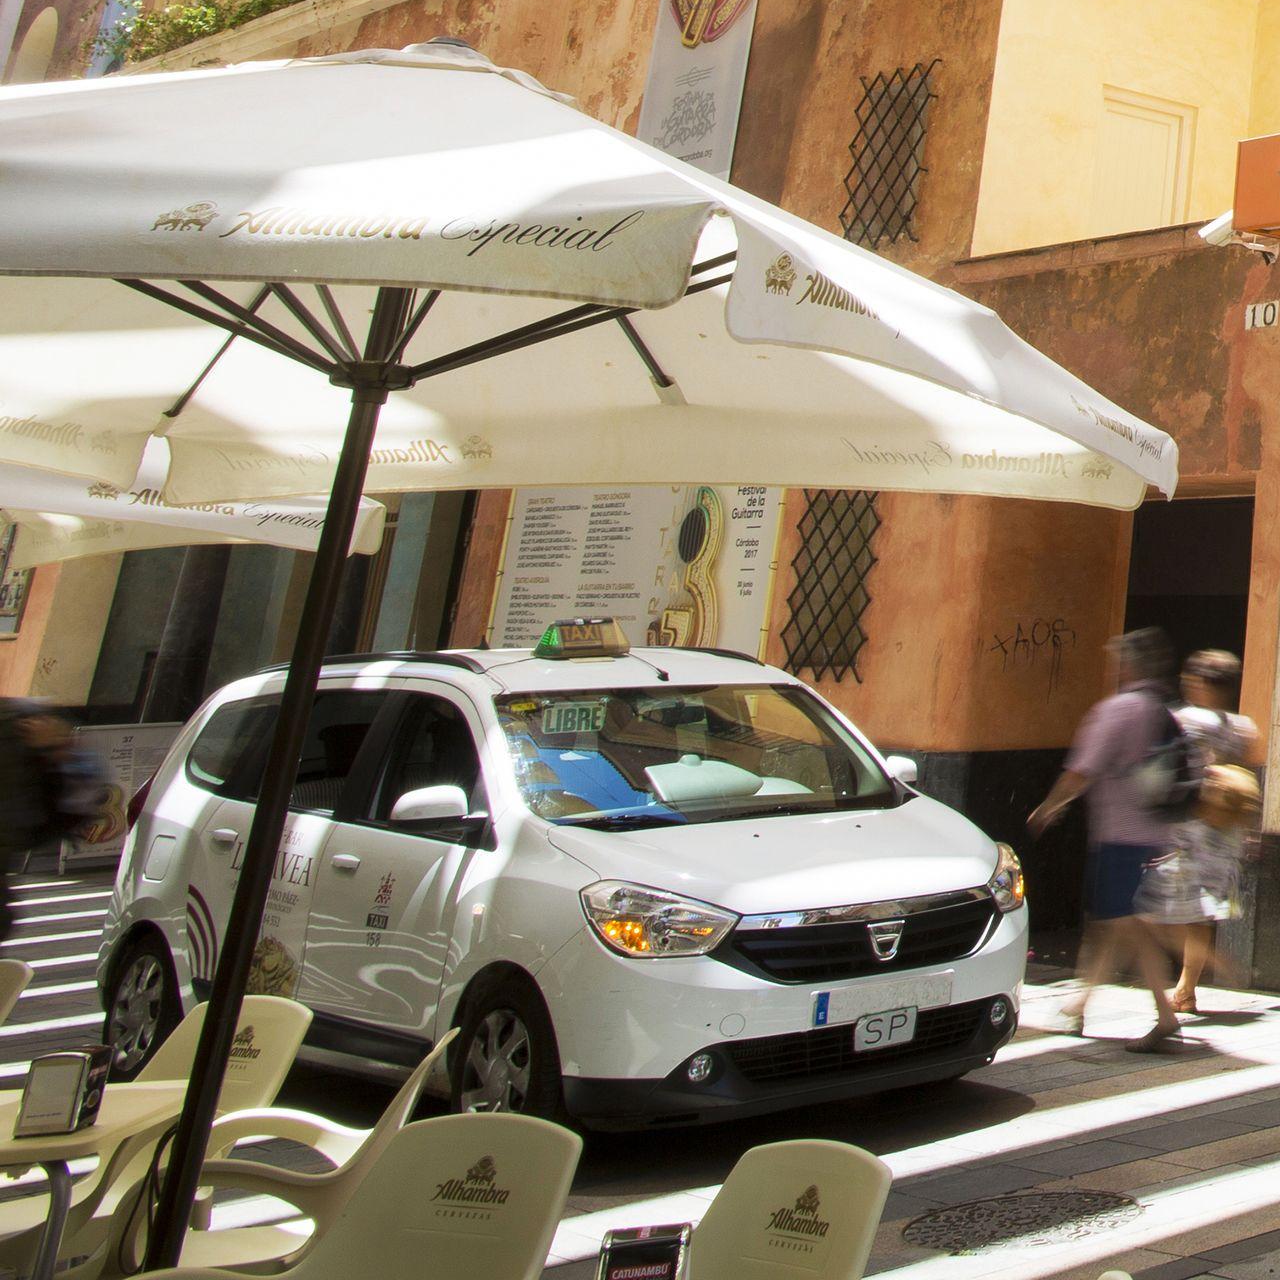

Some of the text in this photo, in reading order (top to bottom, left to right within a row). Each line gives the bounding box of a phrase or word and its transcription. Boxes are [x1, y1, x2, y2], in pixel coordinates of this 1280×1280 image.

[219, 206, 645, 257] Alhambra Especial
[1249, 303, 1276, 328] 10
[747, 496, 765, 506] de la
[732, 508, 764, 519] Guitarra
[736, 538, 759, 547] Córdoba
[744, 550, 758, 558] 2017
[561, 625, 602, 641] TAXI
[545, 706, 603, 732] LIBRE
[369, 915, 386, 928] TAXI
[864, 1013, 908, 1045] SP
[429, 1179, 510, 1205] Alhambra
[435, 1209, 491, 1220] CERVEZAS
[764, 1207, 830, 1238] Alhambra
